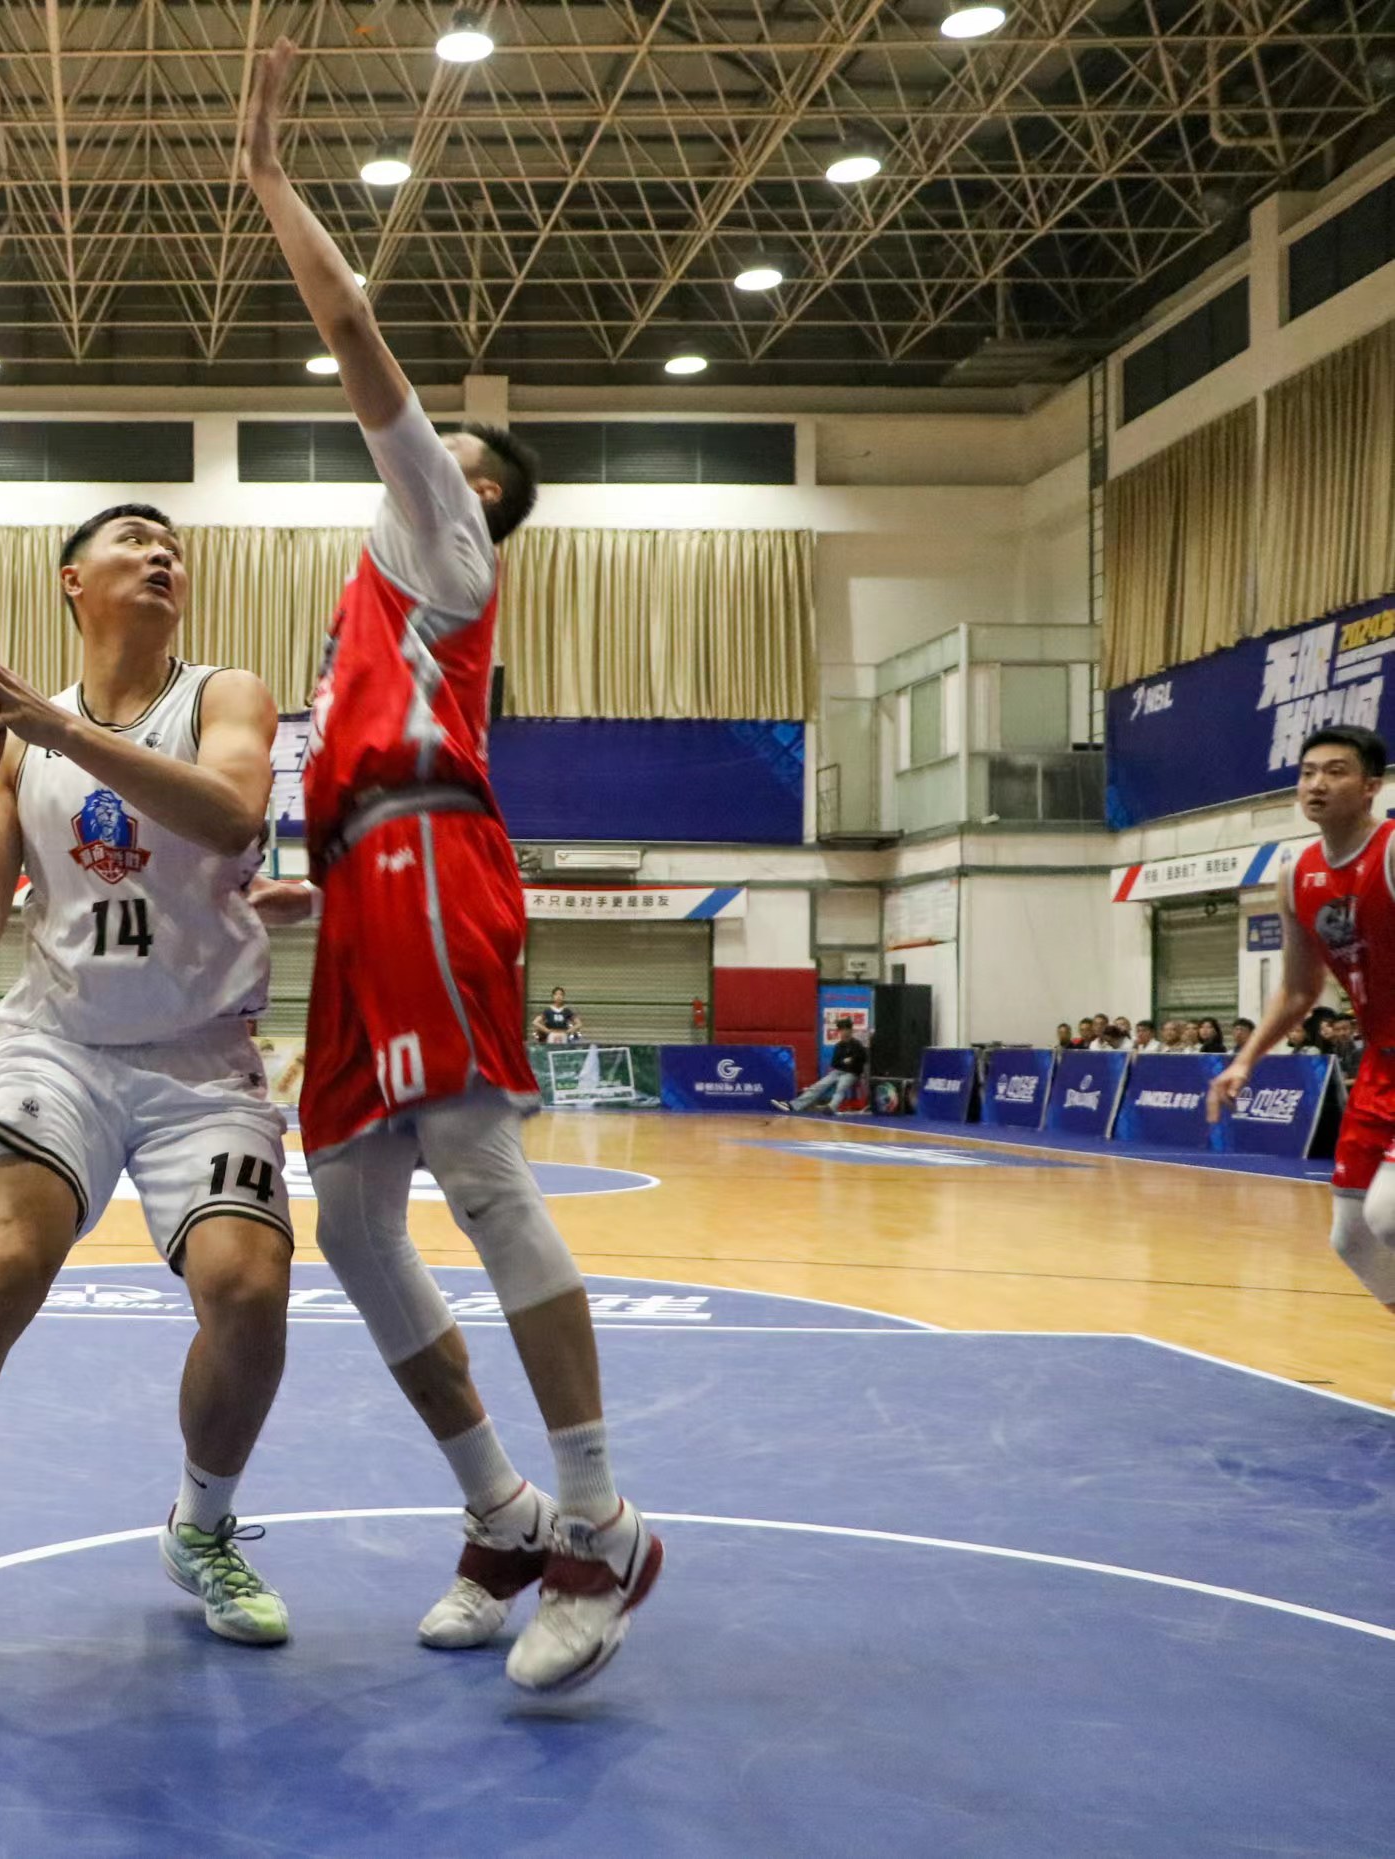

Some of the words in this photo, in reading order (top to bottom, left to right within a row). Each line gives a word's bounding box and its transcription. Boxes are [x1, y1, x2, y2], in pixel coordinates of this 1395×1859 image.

[91, 898, 154, 957] 14
[532, 895, 670, 908] 不只是对手更是朋友
[376, 1030, 427, 1108] 10
[209, 1151, 275, 1203] 14
